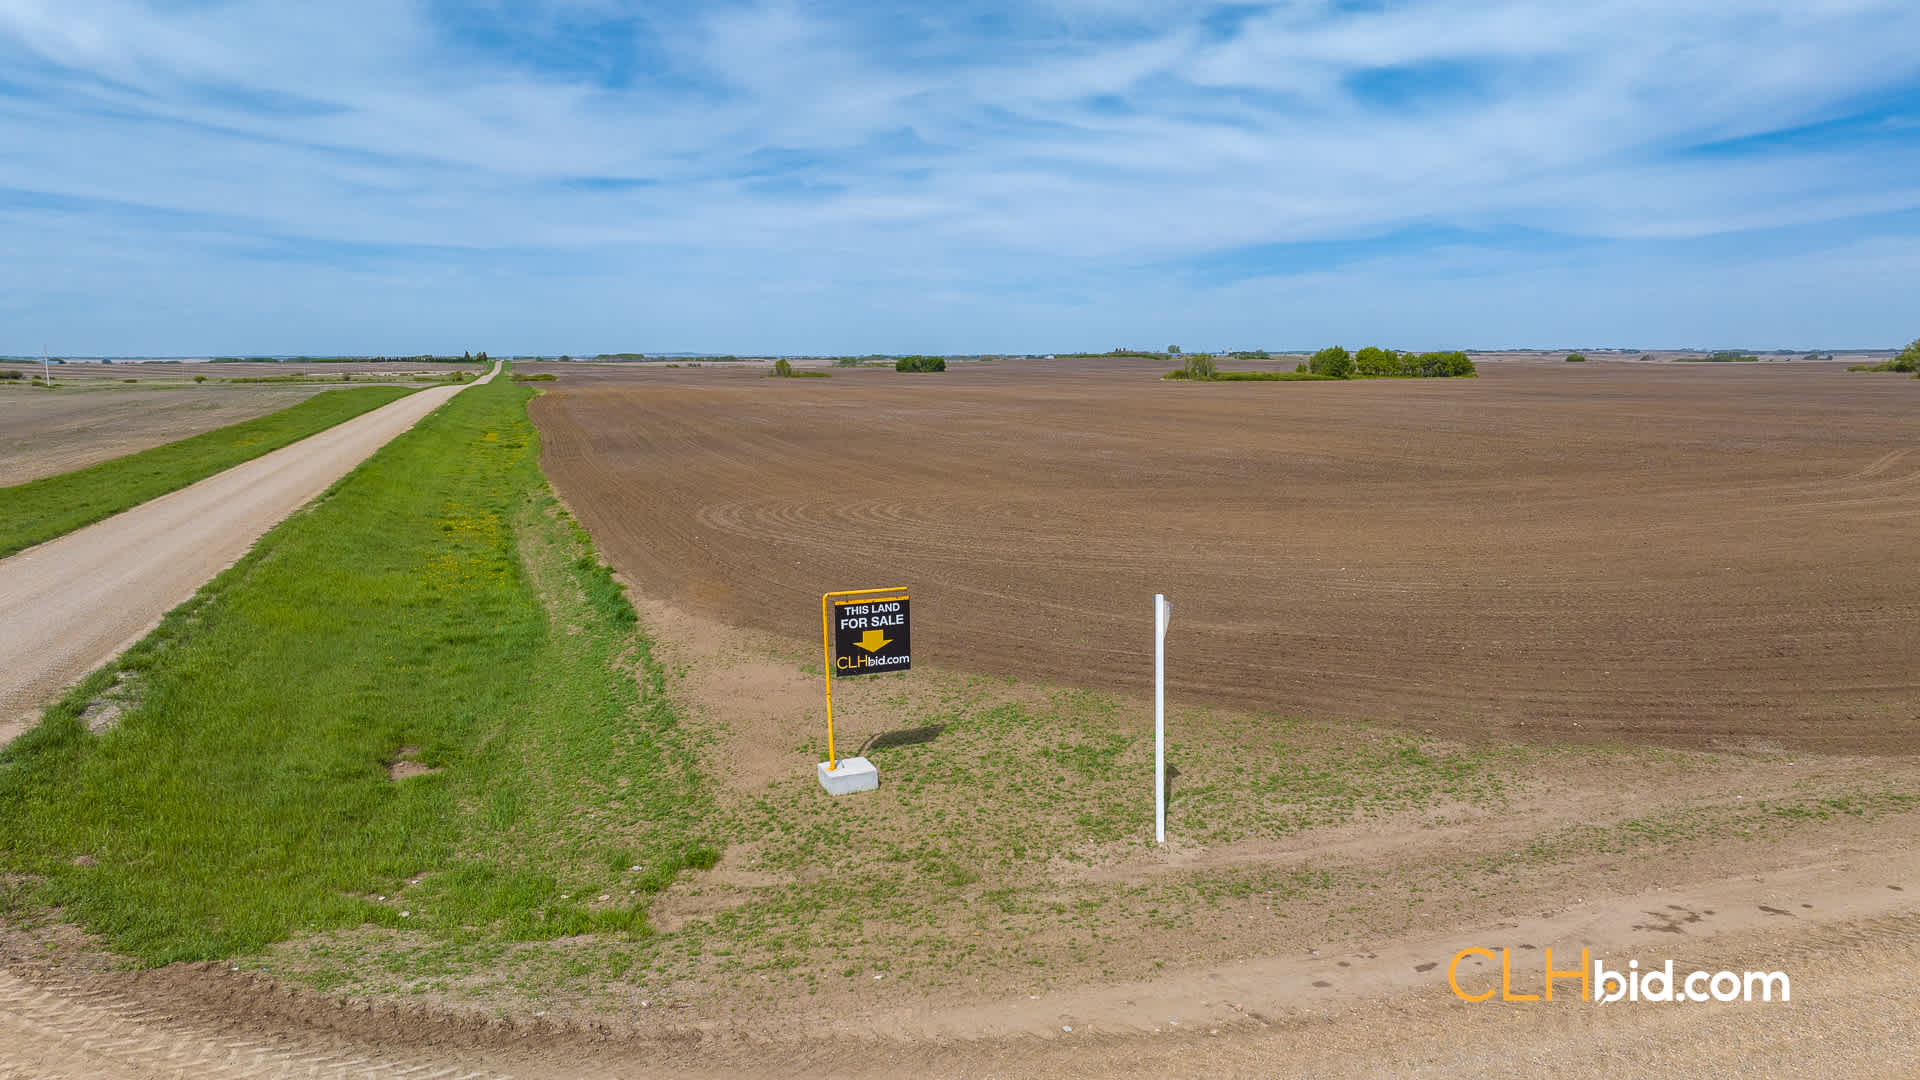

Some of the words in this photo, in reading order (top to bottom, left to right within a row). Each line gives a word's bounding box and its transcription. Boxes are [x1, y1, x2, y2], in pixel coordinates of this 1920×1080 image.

[844, 605, 869, 616] THIS
[872, 602, 900, 613] LAND
[841, 618, 868, 630] FOR
[871, 614, 904, 627] SALE
[837, 655, 910, 670] CLHbid.com
